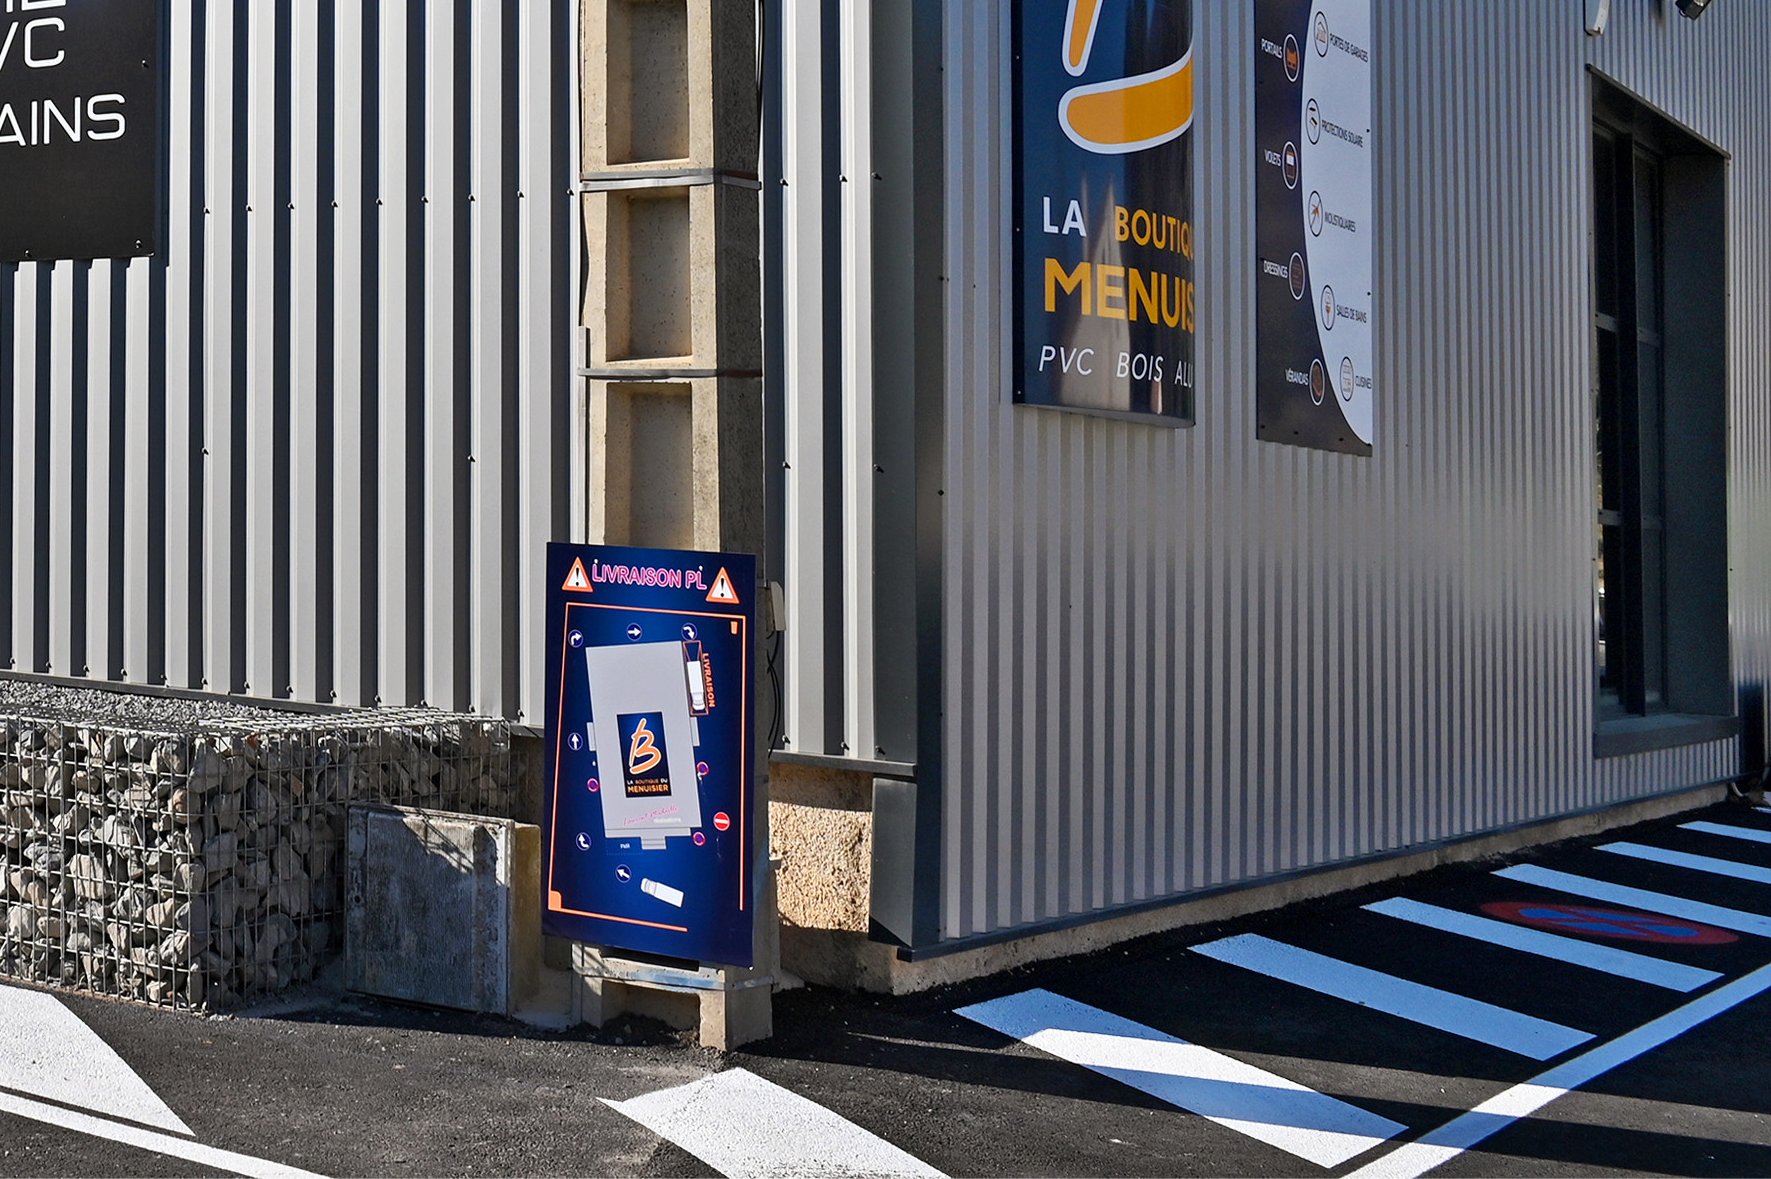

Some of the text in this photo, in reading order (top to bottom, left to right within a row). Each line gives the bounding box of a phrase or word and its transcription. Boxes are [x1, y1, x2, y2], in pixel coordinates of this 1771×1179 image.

[1264, 149, 1282, 167] VOLETS
[1042, 196, 1088, 237] LA
[1263, 260, 1288, 278] DRESSINGS
[1336, 304, 1349, 319] SALLES
[1039, 345, 1094, 376] PVC
[1116, 351, 1164, 383] BOIS
[591, 563, 708, 590] LIVRAISON PL
[702, 653, 716, 708] LIVRAISON
[628, 784, 669, 794] MENUISIER
